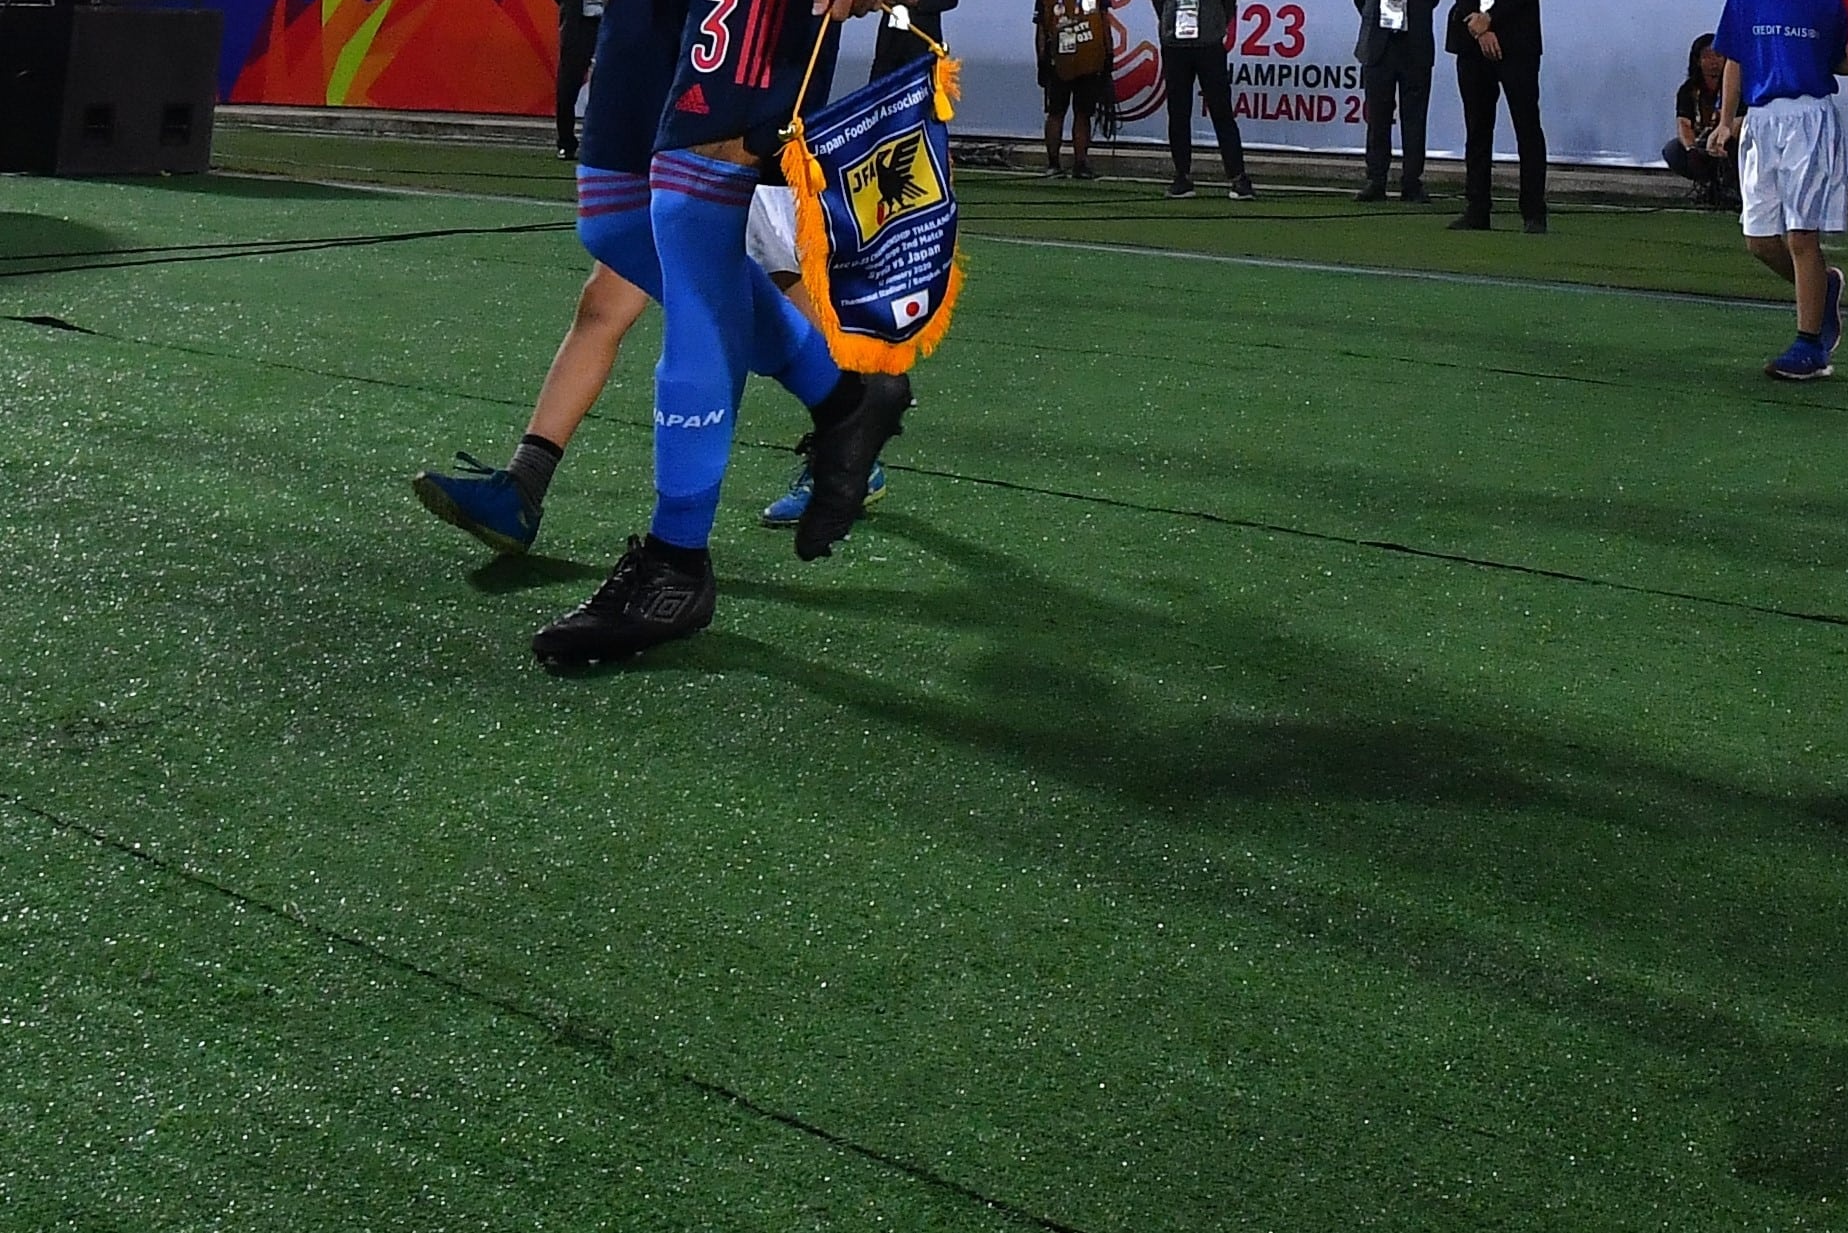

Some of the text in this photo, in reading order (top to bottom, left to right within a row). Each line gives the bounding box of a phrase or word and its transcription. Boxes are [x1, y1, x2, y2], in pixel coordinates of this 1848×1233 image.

[814, 134, 845, 156] Japan
[852, 161, 876, 193] JFA
[907, 244, 942, 265] Japan
[653, 408, 725, 429] APAN
